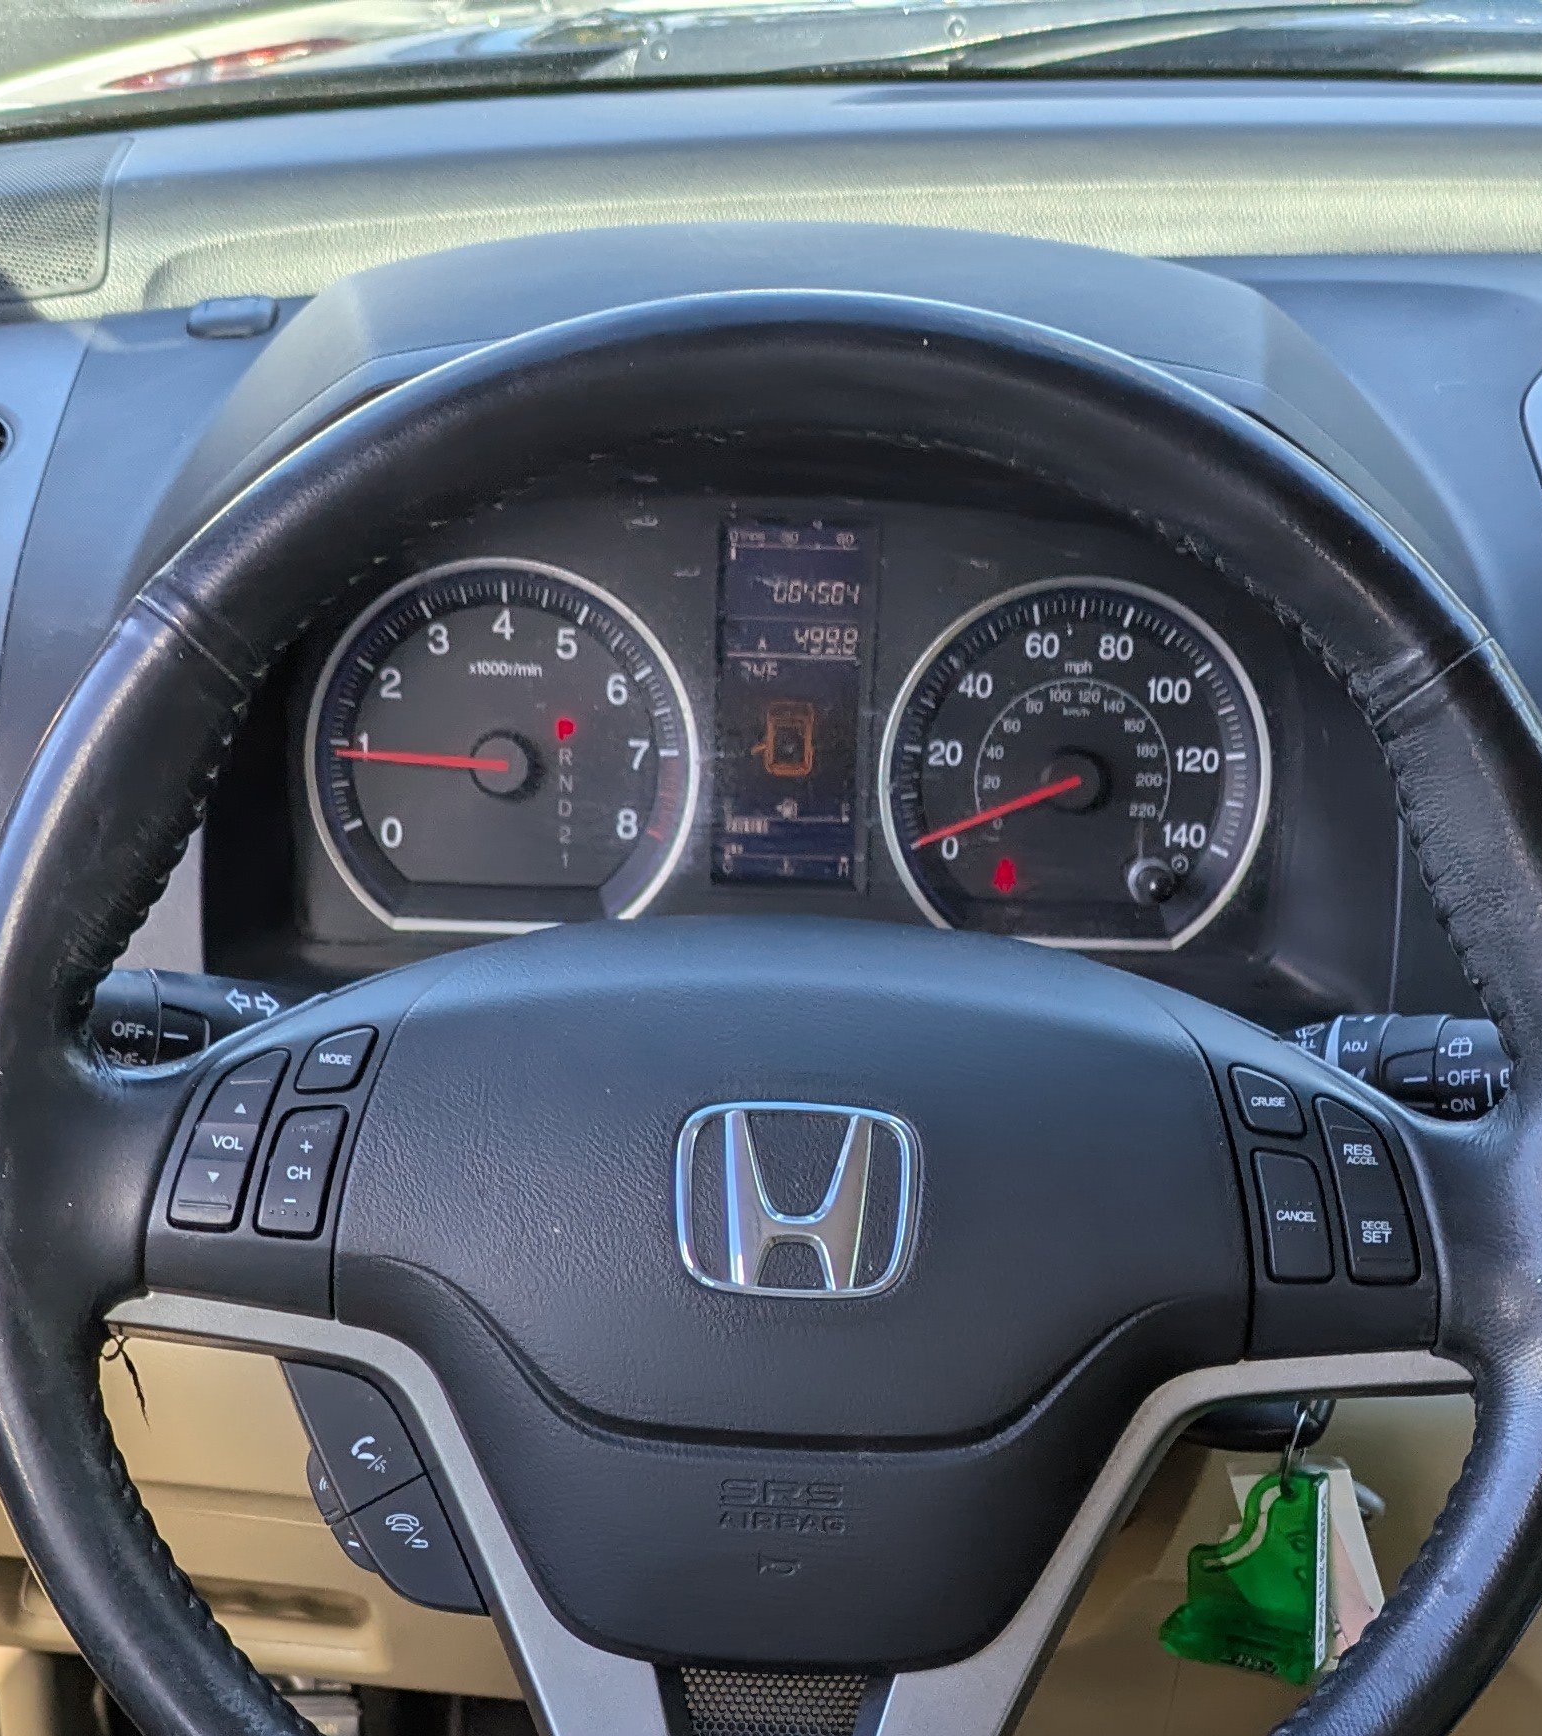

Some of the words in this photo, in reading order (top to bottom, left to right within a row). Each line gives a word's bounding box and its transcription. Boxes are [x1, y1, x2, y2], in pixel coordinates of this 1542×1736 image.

[492, 609, 514, 640] 4
[428, 624, 450, 655] 3
[556, 628, 577, 660] 5
[1025, 632, 1060, 659] 60
[1099, 634, 1134, 661] 80
[469, 659, 543, 678] x1000r/min
[1064, 660, 1093, 676] mph
[380, 668, 402, 700] 2
[606, 674, 628, 705] 6
[958, 672, 993, 699] 40
[1148, 677, 1192, 704] 100
[556, 717, 575, 740] P
[561, 748, 573, 765] R
[628, 739, 651, 770] 7
[928, 740, 963, 767] 20
[1176, 747, 1219, 773] 120
[560, 774, 573, 792] N
[561, 801, 573, 817] D
[381, 817, 402, 848] 0
[616, 809, 638, 840] 8
[560, 828, 572, 843] 2
[1163, 823, 1206, 849] 140
[941, 836, 959, 860] 0
[1342, 1040, 1368, 1052] ADJ
[319, 1053, 352, 1066] MODE
[1447, 1069, 1481, 1086] OFF
[1250, 1096, 1286, 1108] CRUISE
[1450, 1097, 1476, 1112] ON
[211, 1134, 244, 1151] VOL
[1343, 1143, 1373, 1157] RES
[1346, 1154, 1379, 1166] ACCEL
[286, 1165, 311, 1181] CH
[1276, 1209, 1317, 1223] CANCEL
[1361, 1220, 1392, 1231] DECEL
[1362, 1230, 1392, 1244] SET
[718, 1510, 847, 1536] AIRBAG
